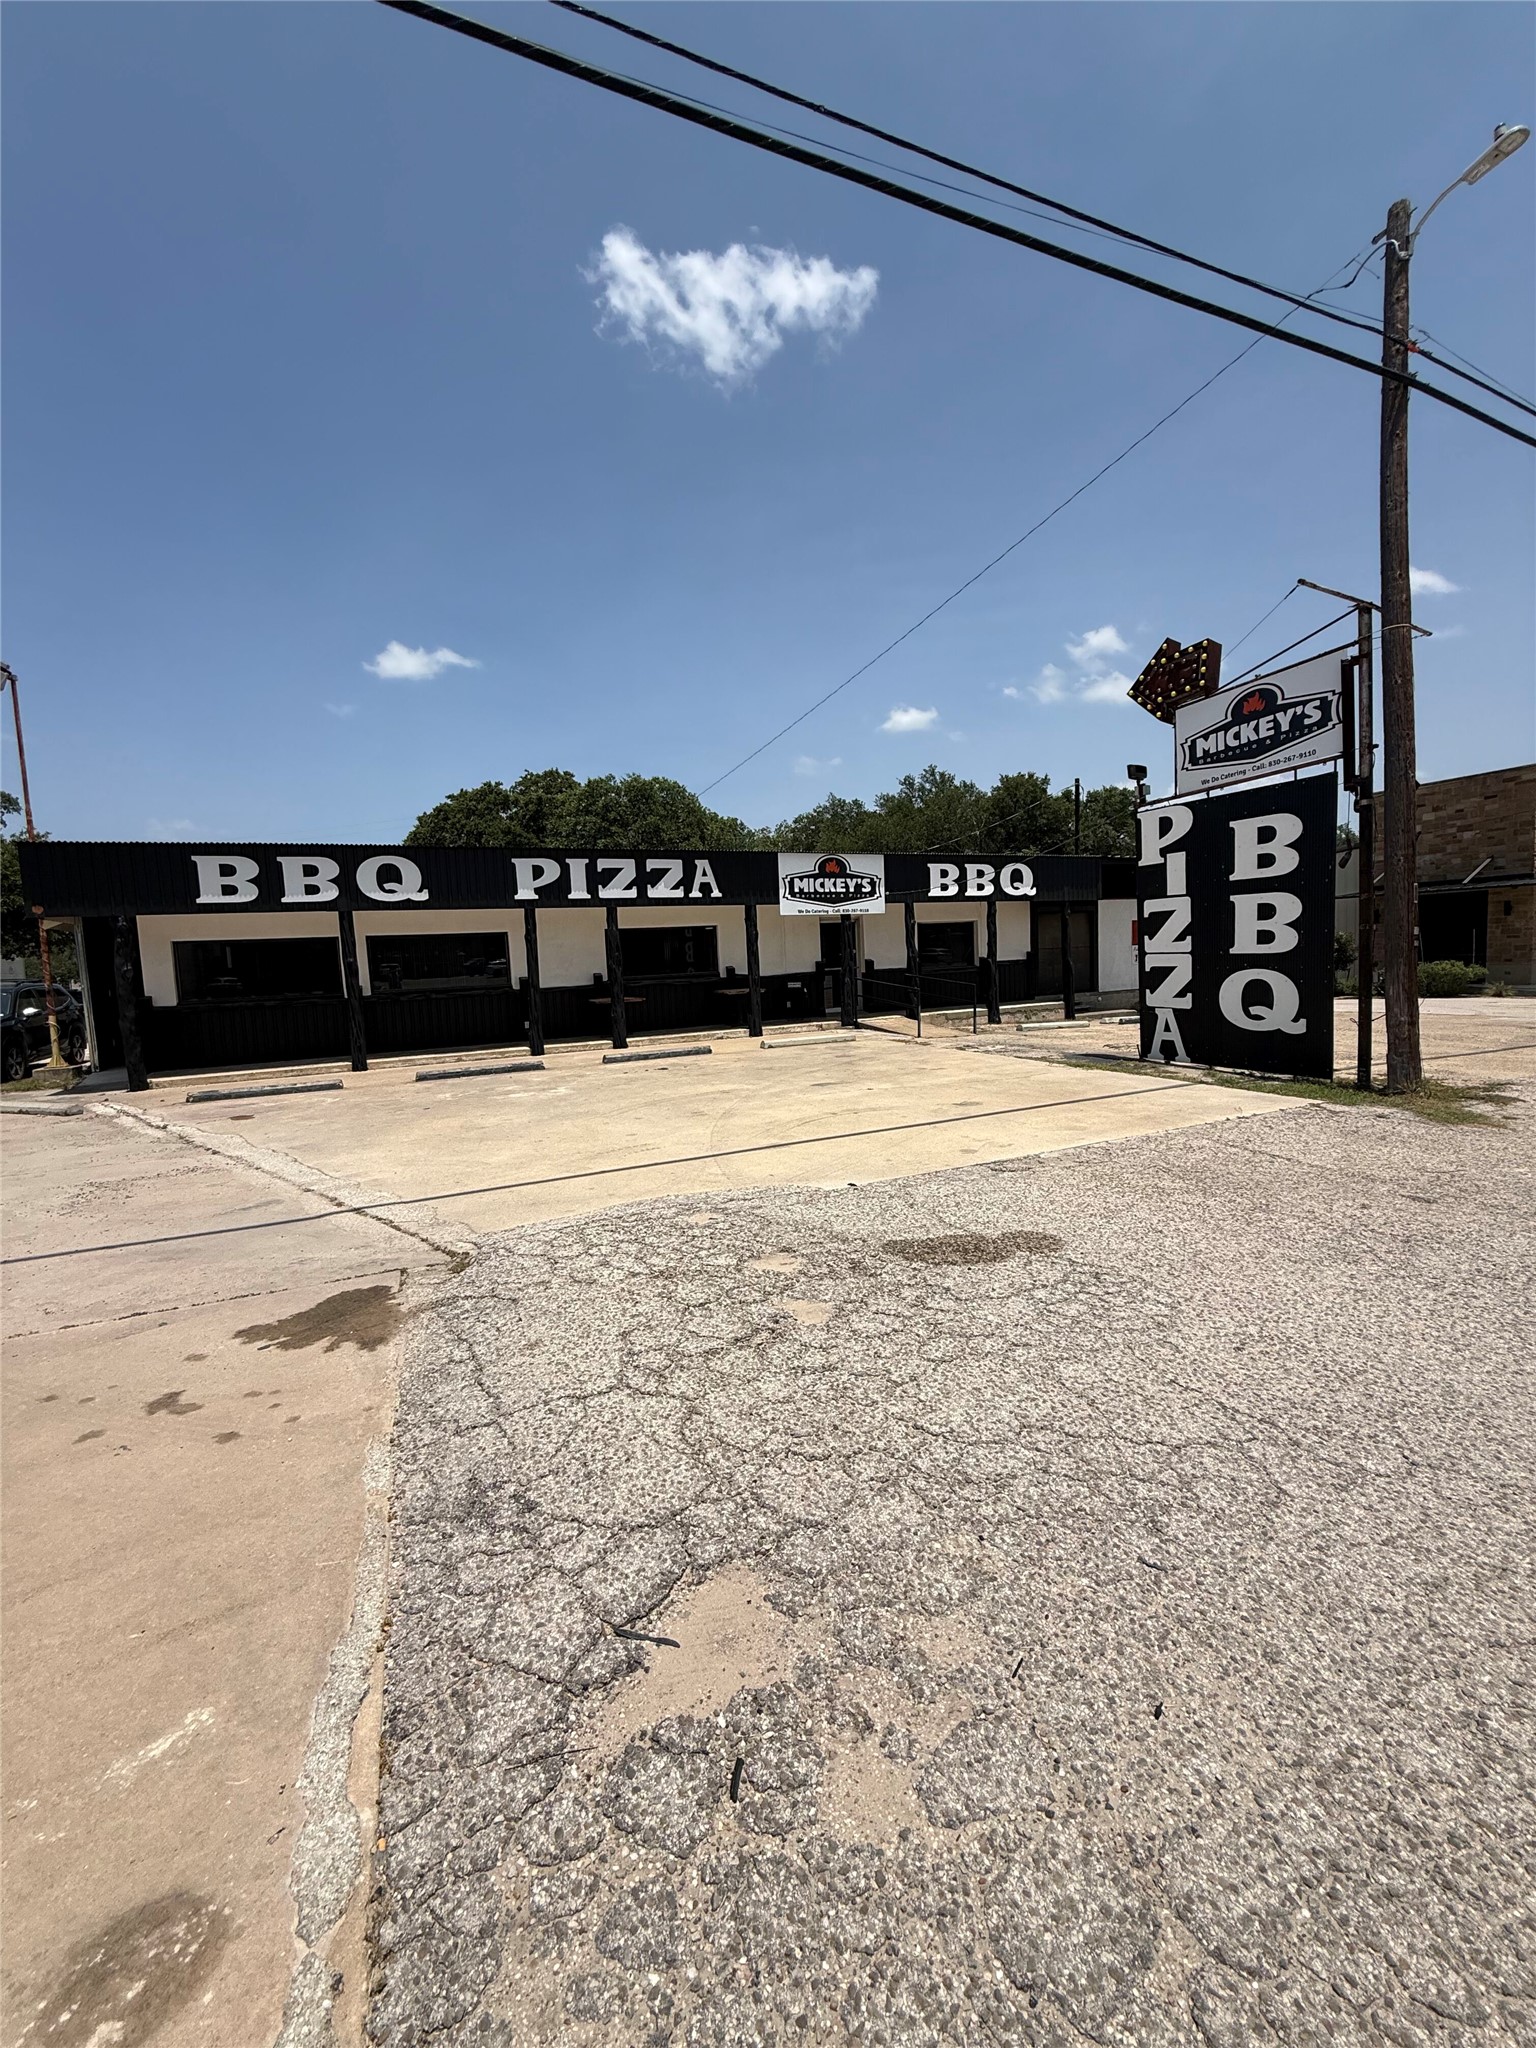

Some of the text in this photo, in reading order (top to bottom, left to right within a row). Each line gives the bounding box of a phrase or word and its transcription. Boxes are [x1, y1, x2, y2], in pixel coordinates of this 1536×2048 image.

[1195, 700, 1322, 758] MICKEY'S
[1198, 744, 1257, 764] Barbecue
[1280, 725, 1318, 741] Pizza
[1200, 777, 1211, 786] We
[1220, 769, 1247, 781] Catering
[1252, 763, 1267, 771] Call:
[1268, 749, 1317, 767] 830-267-9110
[191, 855, 429, 904] BBQ
[511, 857, 723, 900] PIZZA
[793, 877, 872, 893] MICKEY'S
[927, 863, 1037, 897] BBQ
[1137, 804, 1193, 1063] PIZZA
[1218, 812, 1307, 1035] BBQ
